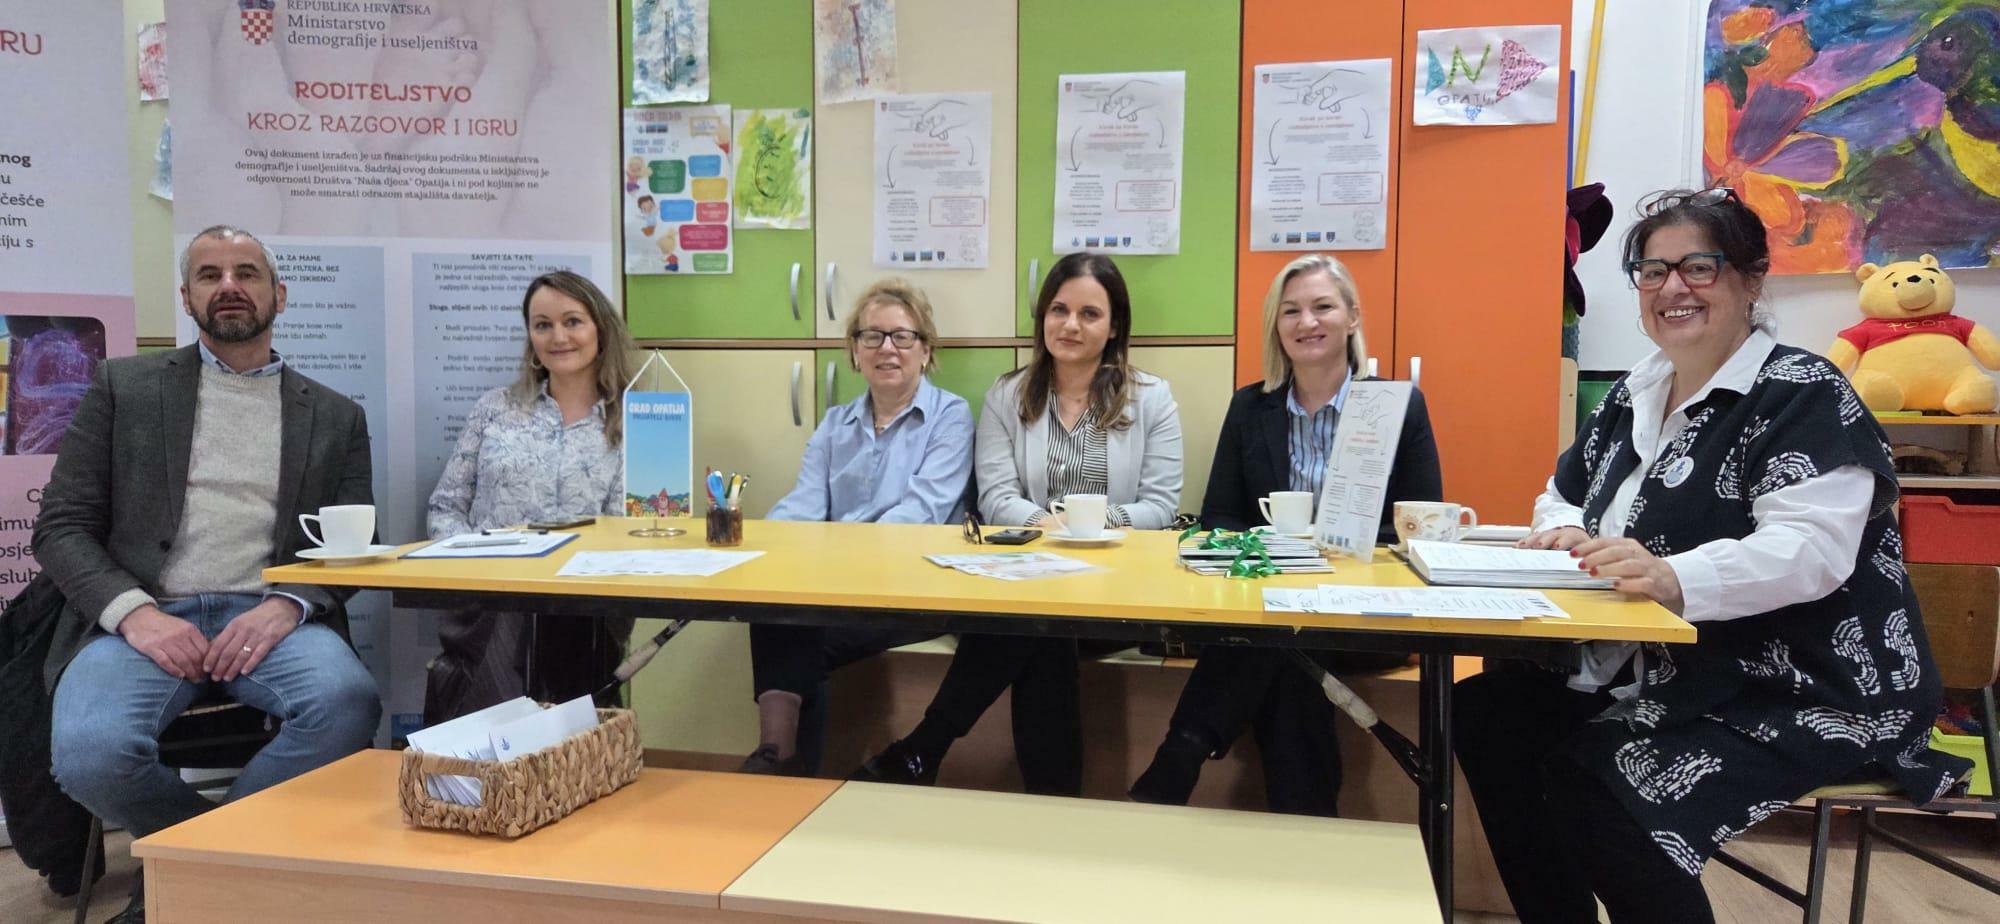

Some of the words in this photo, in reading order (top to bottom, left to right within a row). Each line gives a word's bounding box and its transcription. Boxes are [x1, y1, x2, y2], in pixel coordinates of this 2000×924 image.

[287, 0, 360, 12] REPUBLIKA
[363, 2, 431, 16] HRVATSKA
[288, 15, 385, 31] Ministarstvo
[288, 31, 378, 50] demografije
[381, 34, 387, 48] i
[390, 36, 478, 51] useljeništva
[295, 81, 472, 103] RODITELJSTVO
[248, 112, 312, 132] KROZ
[320, 114, 446, 136] RAZGOVOR
[454, 118, 460, 136] I
[469, 118, 518, 137] IGRU
[245, 148, 268, 159] Ovaj
[270, 149, 319, 160] dokument
[360, 151, 369, 162] je
[371, 153, 382, 161] uz
[384, 152, 437, 164] financijsku
[439, 153, 477, 165] podršku
[479, 154, 539, 164] Ministarstva
[235, 161, 293, 172] demografije
[301, 162, 363, 174] useljeništva.
[365, 164, 401, 176] Sadržaj
[403, 167, 426, 177] ovog
[428, 165, 481, 176] dokumenta
[540, 167, 550, 179] je
[246, 174, 311, 185] odgovornosti
[313, 175, 352, 186] Društva
[415, 178, 452, 189] Opatija
[468, 179, 485, 190] pod
[291, 188, 316, 197] može
[318, 189, 359, 198] smatrati
[362, 189, 402, 199] odrazom
[405, 190, 450, 201] stajališta
[25, 238, 34, 248] s
[27, 487, 46, 503] C
